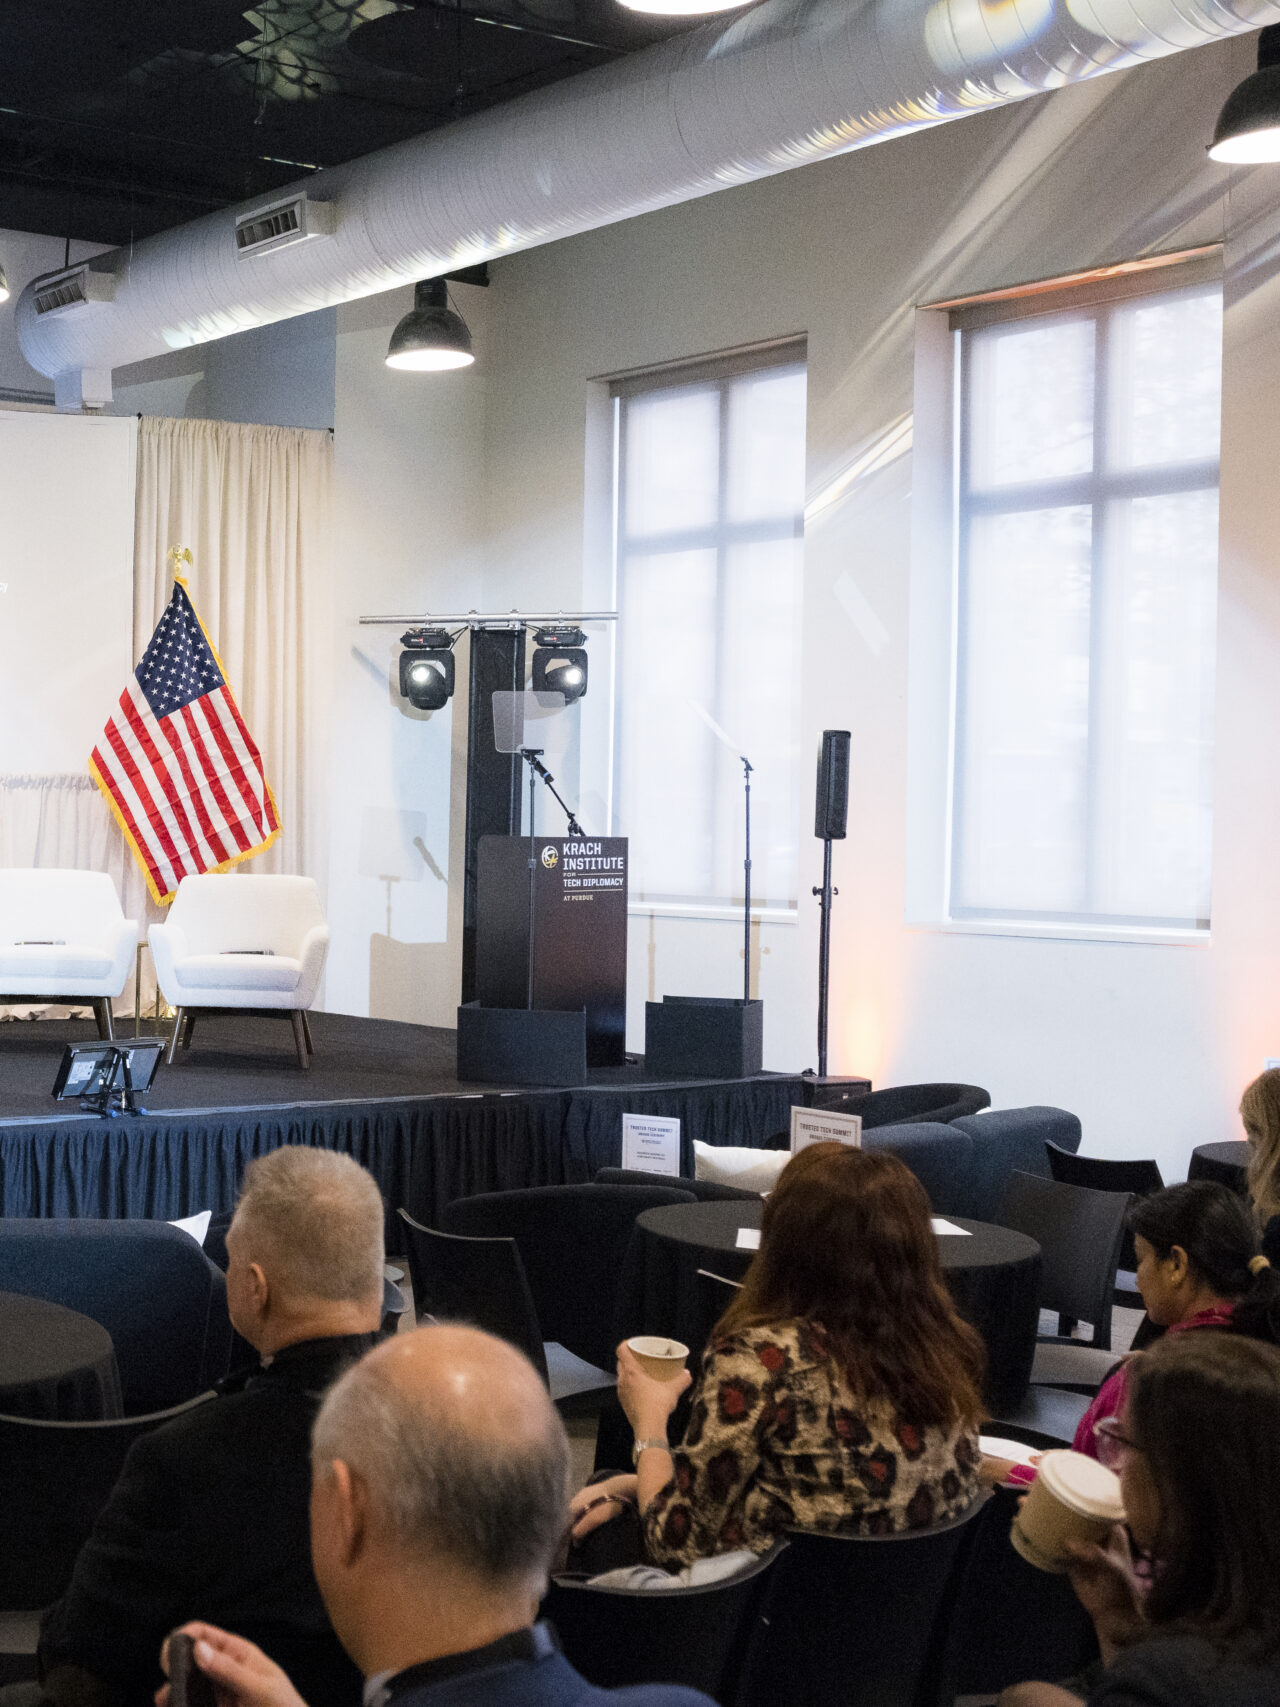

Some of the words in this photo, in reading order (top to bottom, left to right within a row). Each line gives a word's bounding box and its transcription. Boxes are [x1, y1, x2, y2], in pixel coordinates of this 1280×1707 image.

[563, 842, 601, 855] KRACH
[563, 857, 624, 870] INSTITUTE
[563, 879, 581, 888] TECH
[583, 877, 624, 887] DIPLOMACY
